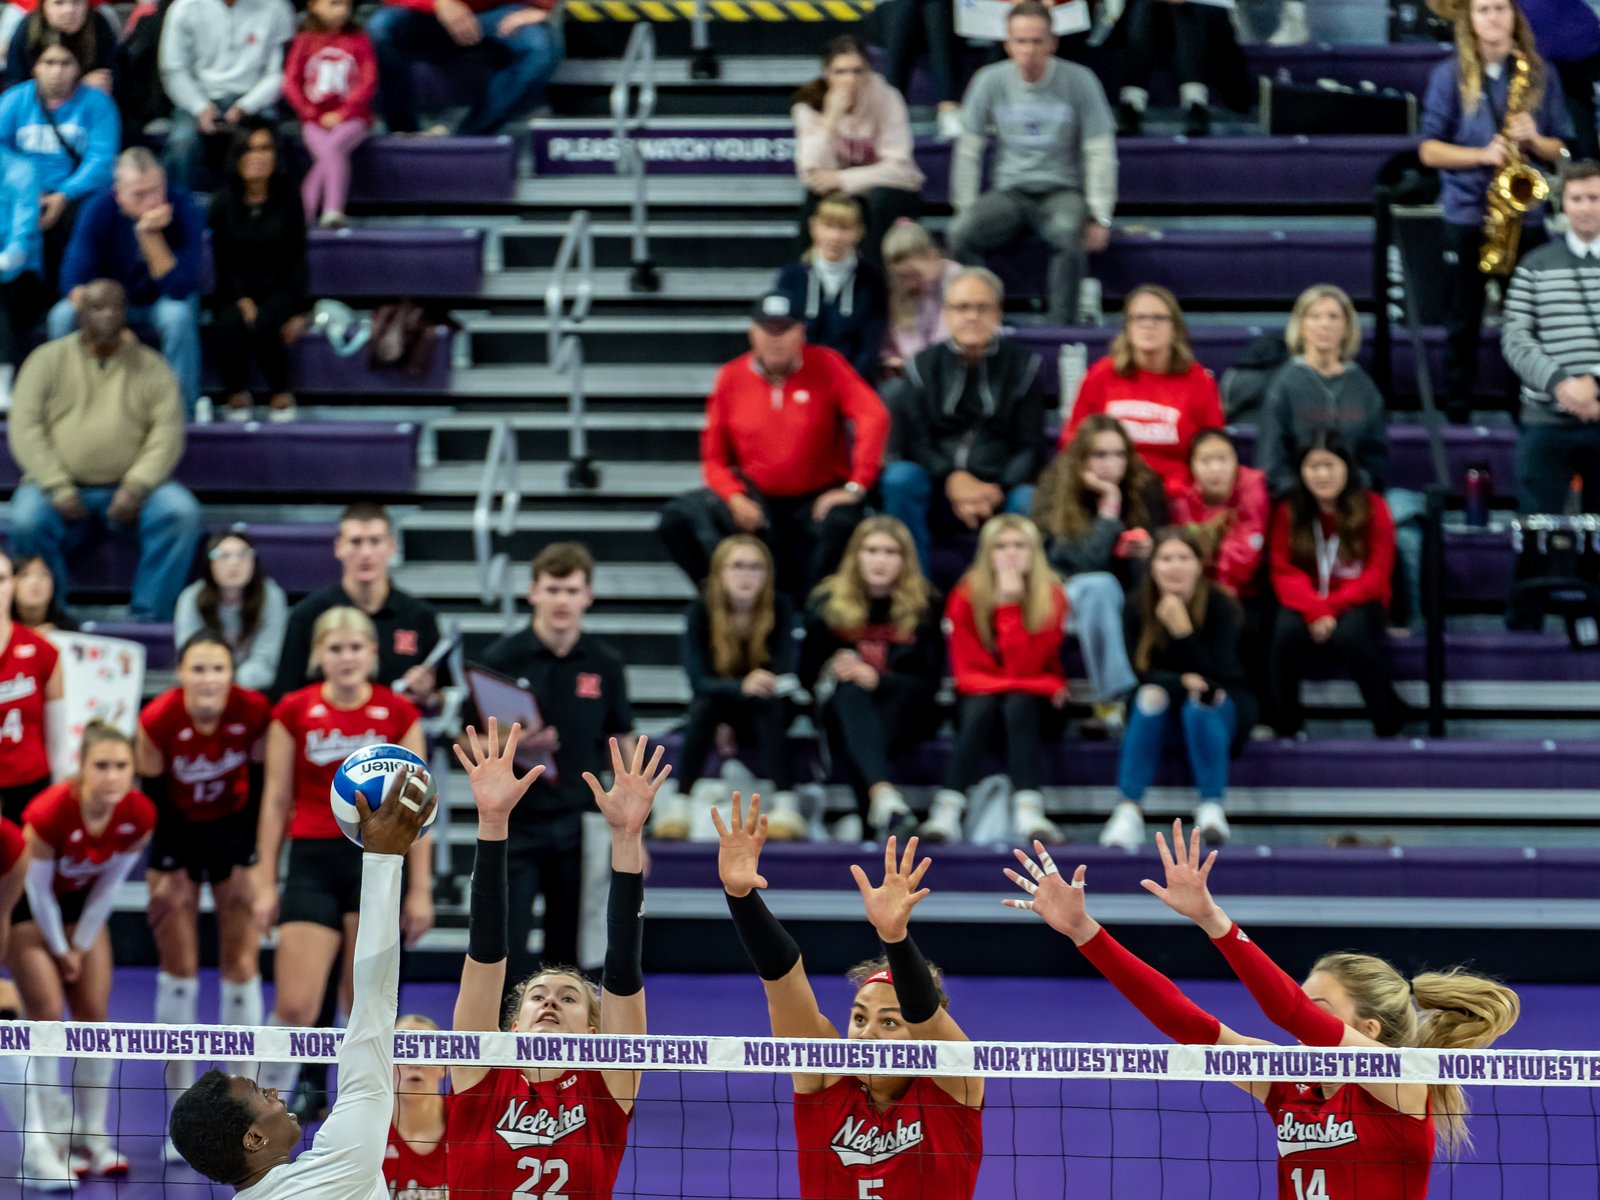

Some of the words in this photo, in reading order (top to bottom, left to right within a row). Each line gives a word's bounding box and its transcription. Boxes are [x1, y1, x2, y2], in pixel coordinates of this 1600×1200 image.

[549, 137, 636, 161] PLEAS
[65, 1027, 255, 1056] NORTHWESTERN
[289, 1032, 480, 1060] NORESTERN
[516, 1036, 708, 1065] NORTHWESTERN
[744, 1041, 937, 1069] NORTHWESTERN
[973, 1046, 1169, 1074] NORTHWESTERN
[1205, 1050, 1401, 1078] NORTHWESTERN
[1438, 1054, 1600, 1080] NORTHWESTE
[1277, 1110, 1358, 1142] ebraska
